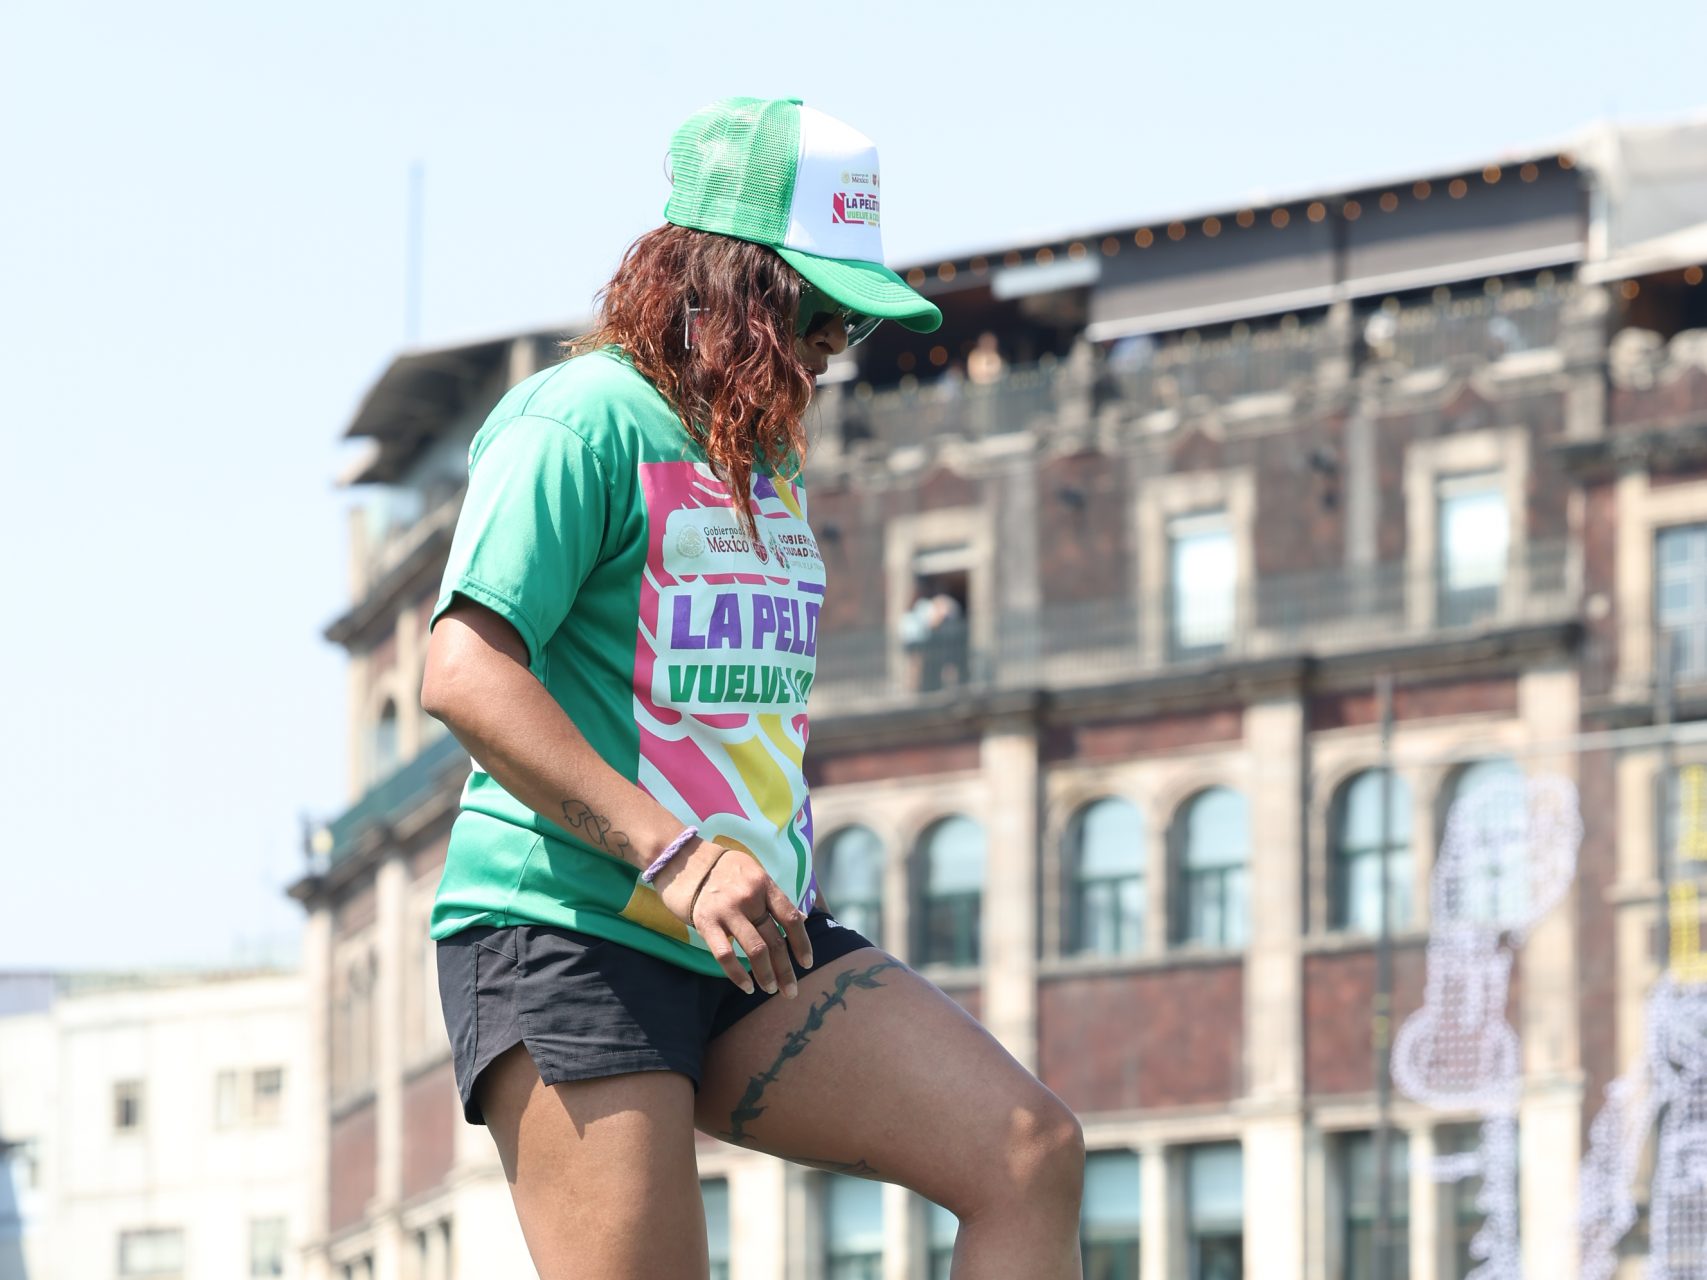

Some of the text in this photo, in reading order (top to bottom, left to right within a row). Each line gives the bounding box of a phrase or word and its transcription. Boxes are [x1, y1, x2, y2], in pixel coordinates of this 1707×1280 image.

[846, 198, 857, 208] LA
[703, 526, 739, 536] Gobierno
[706, 535, 750, 553] México
[671, 593, 742, 650] LA
[668, 664, 791, 704] VUELVE
